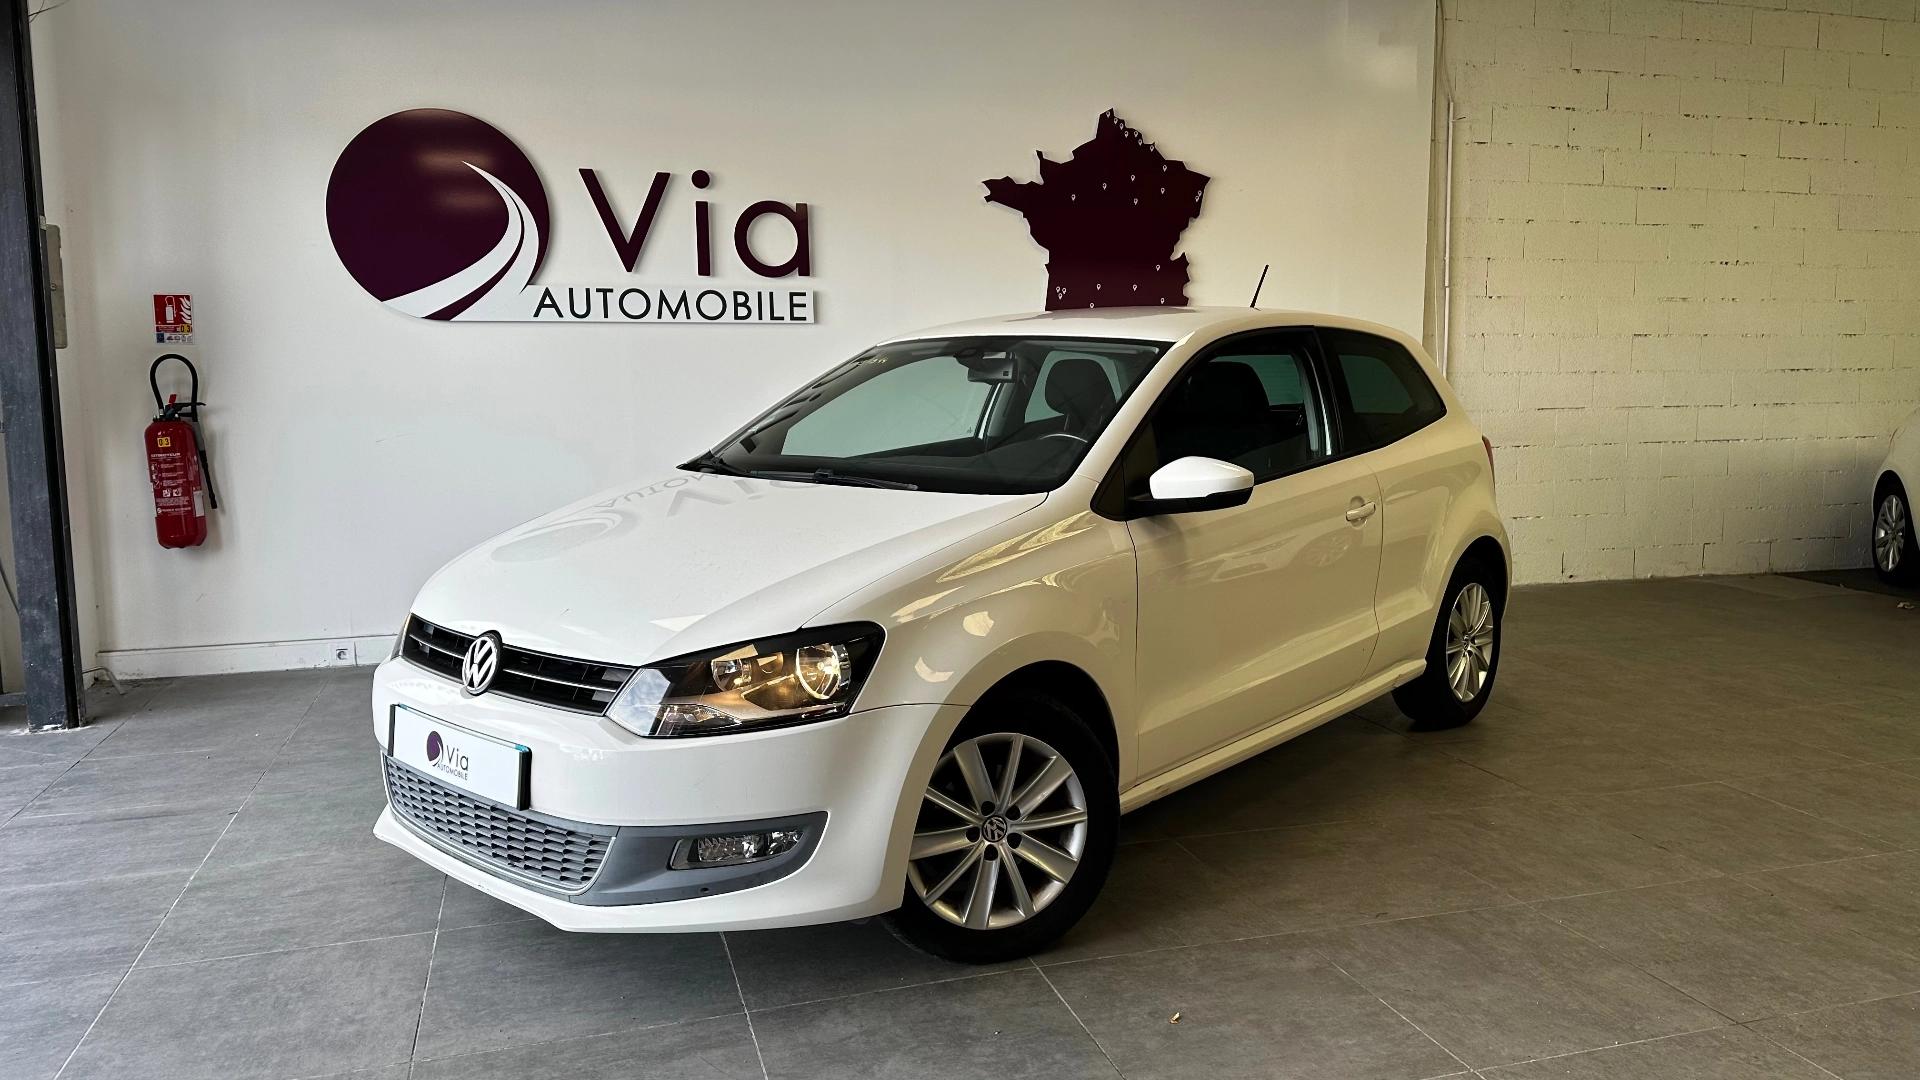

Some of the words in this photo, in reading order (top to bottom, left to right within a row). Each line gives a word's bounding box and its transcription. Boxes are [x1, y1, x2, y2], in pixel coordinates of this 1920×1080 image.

[579, 168, 811, 278] Via
[533, 286, 807, 321] AUTOMOBILE
[437, 763, 468, 781] AUTOMOBILE
[446, 744, 469, 771] Via
